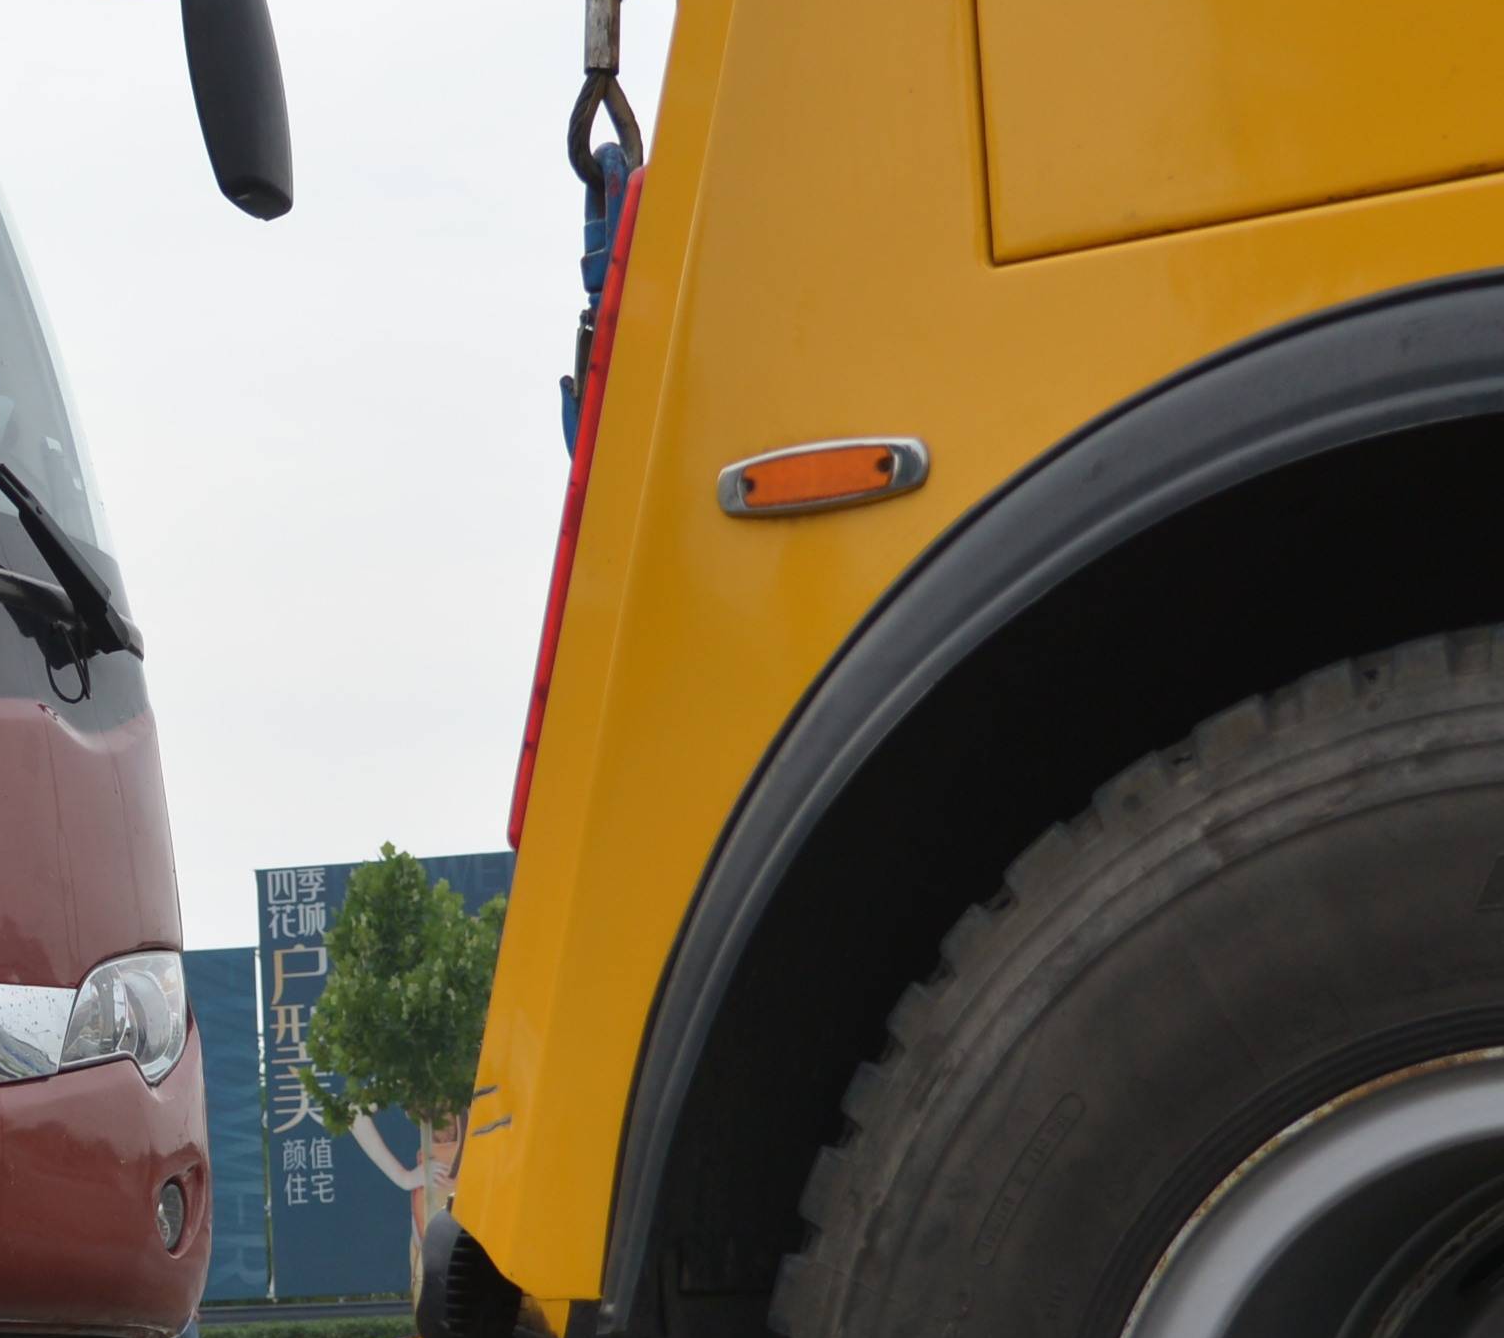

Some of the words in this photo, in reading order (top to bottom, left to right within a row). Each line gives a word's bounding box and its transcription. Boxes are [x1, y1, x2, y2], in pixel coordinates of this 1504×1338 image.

[267, 867, 326, 904] 四季
[267, 904, 326, 940] 花城
[282, 1138, 334, 1172] 颜值
[283, 1171, 335, 1205] 住宅
